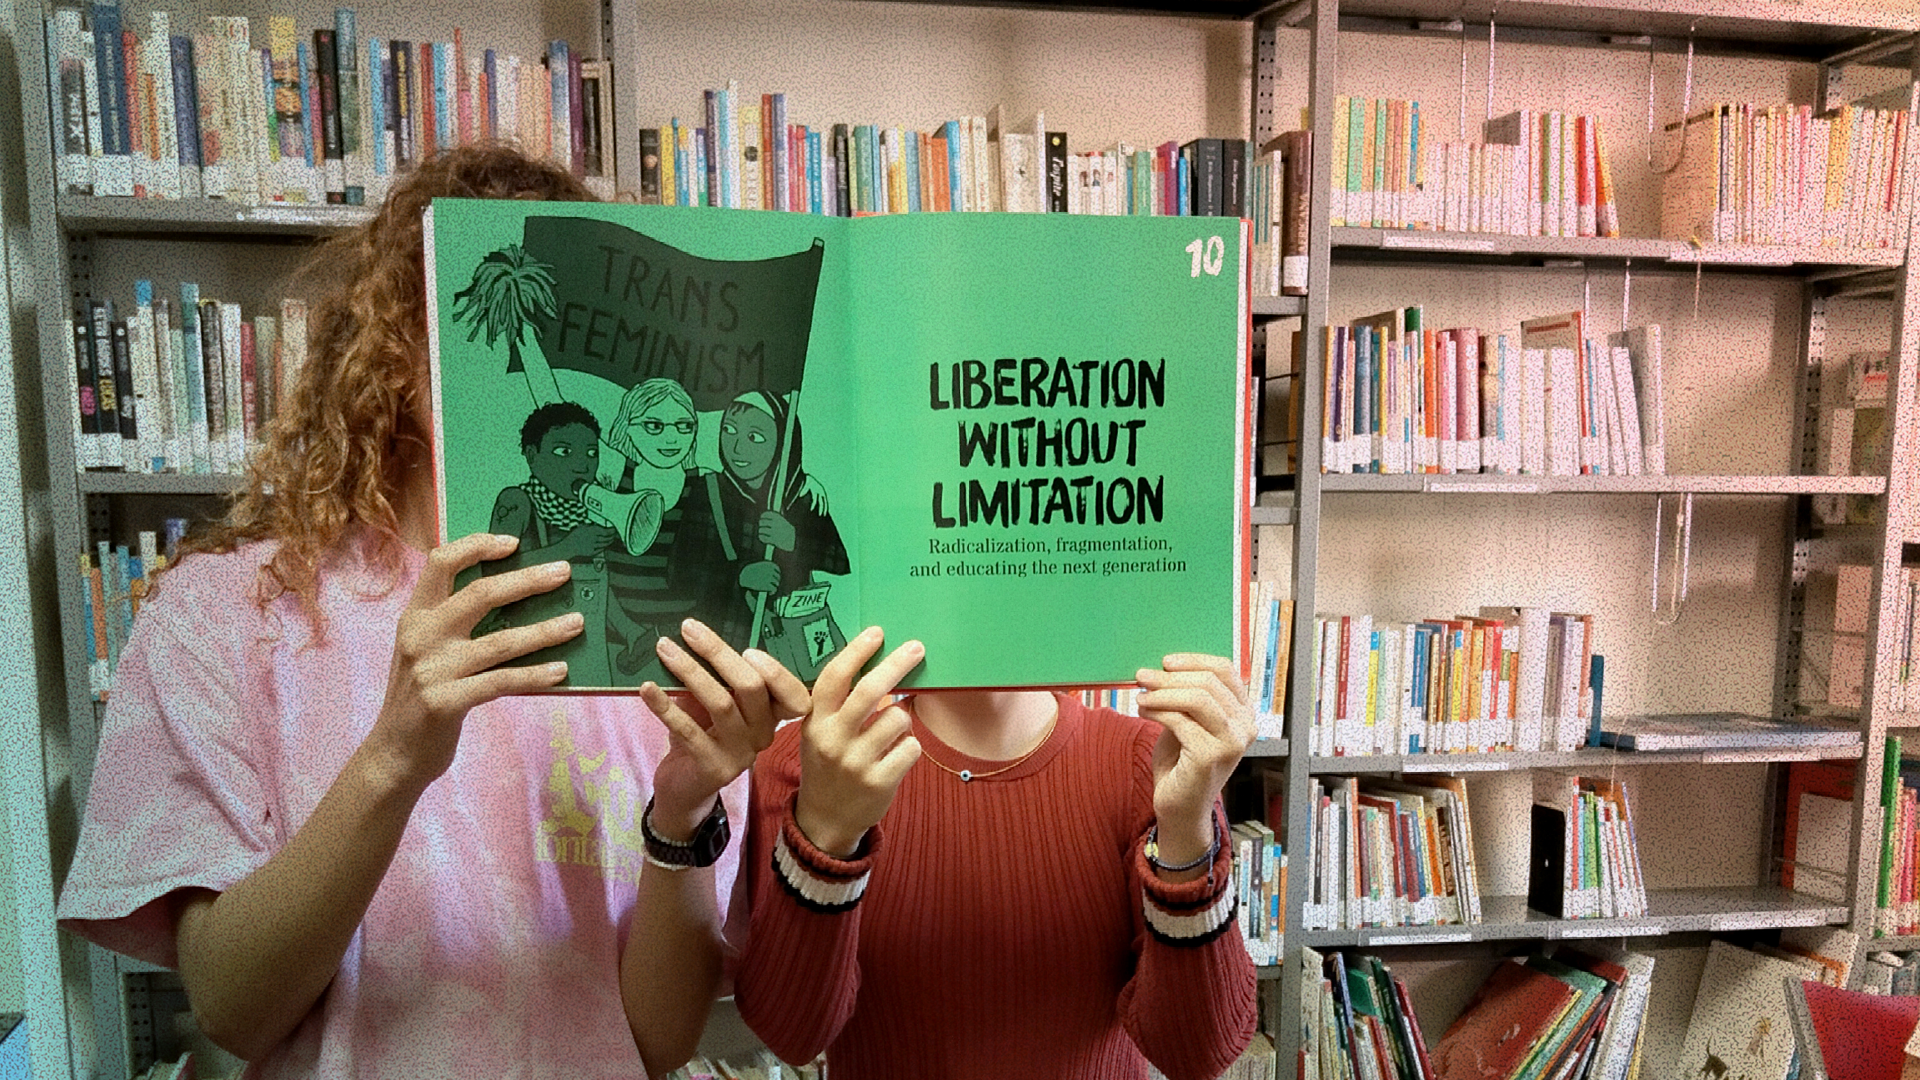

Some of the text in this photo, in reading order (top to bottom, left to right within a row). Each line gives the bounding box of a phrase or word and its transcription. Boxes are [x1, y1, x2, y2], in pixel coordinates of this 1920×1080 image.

[1185, 235, 1224, 278] 10
[598, 245, 740, 332] TRANS
[557, 301, 766, 393] FEMINISM
[98, 378, 117, 411] LUCAS
[930, 357, 1165, 410] LIBERATION
[959, 417, 1146, 468] WITHOUT
[932, 475, 1164, 529] LIMITATION
[909, 557, 1187, 577] and educating the next generation
[928, 536, 1173, 555] Radicalization, fragmentation,
[792, 592, 825, 608] ZINE
